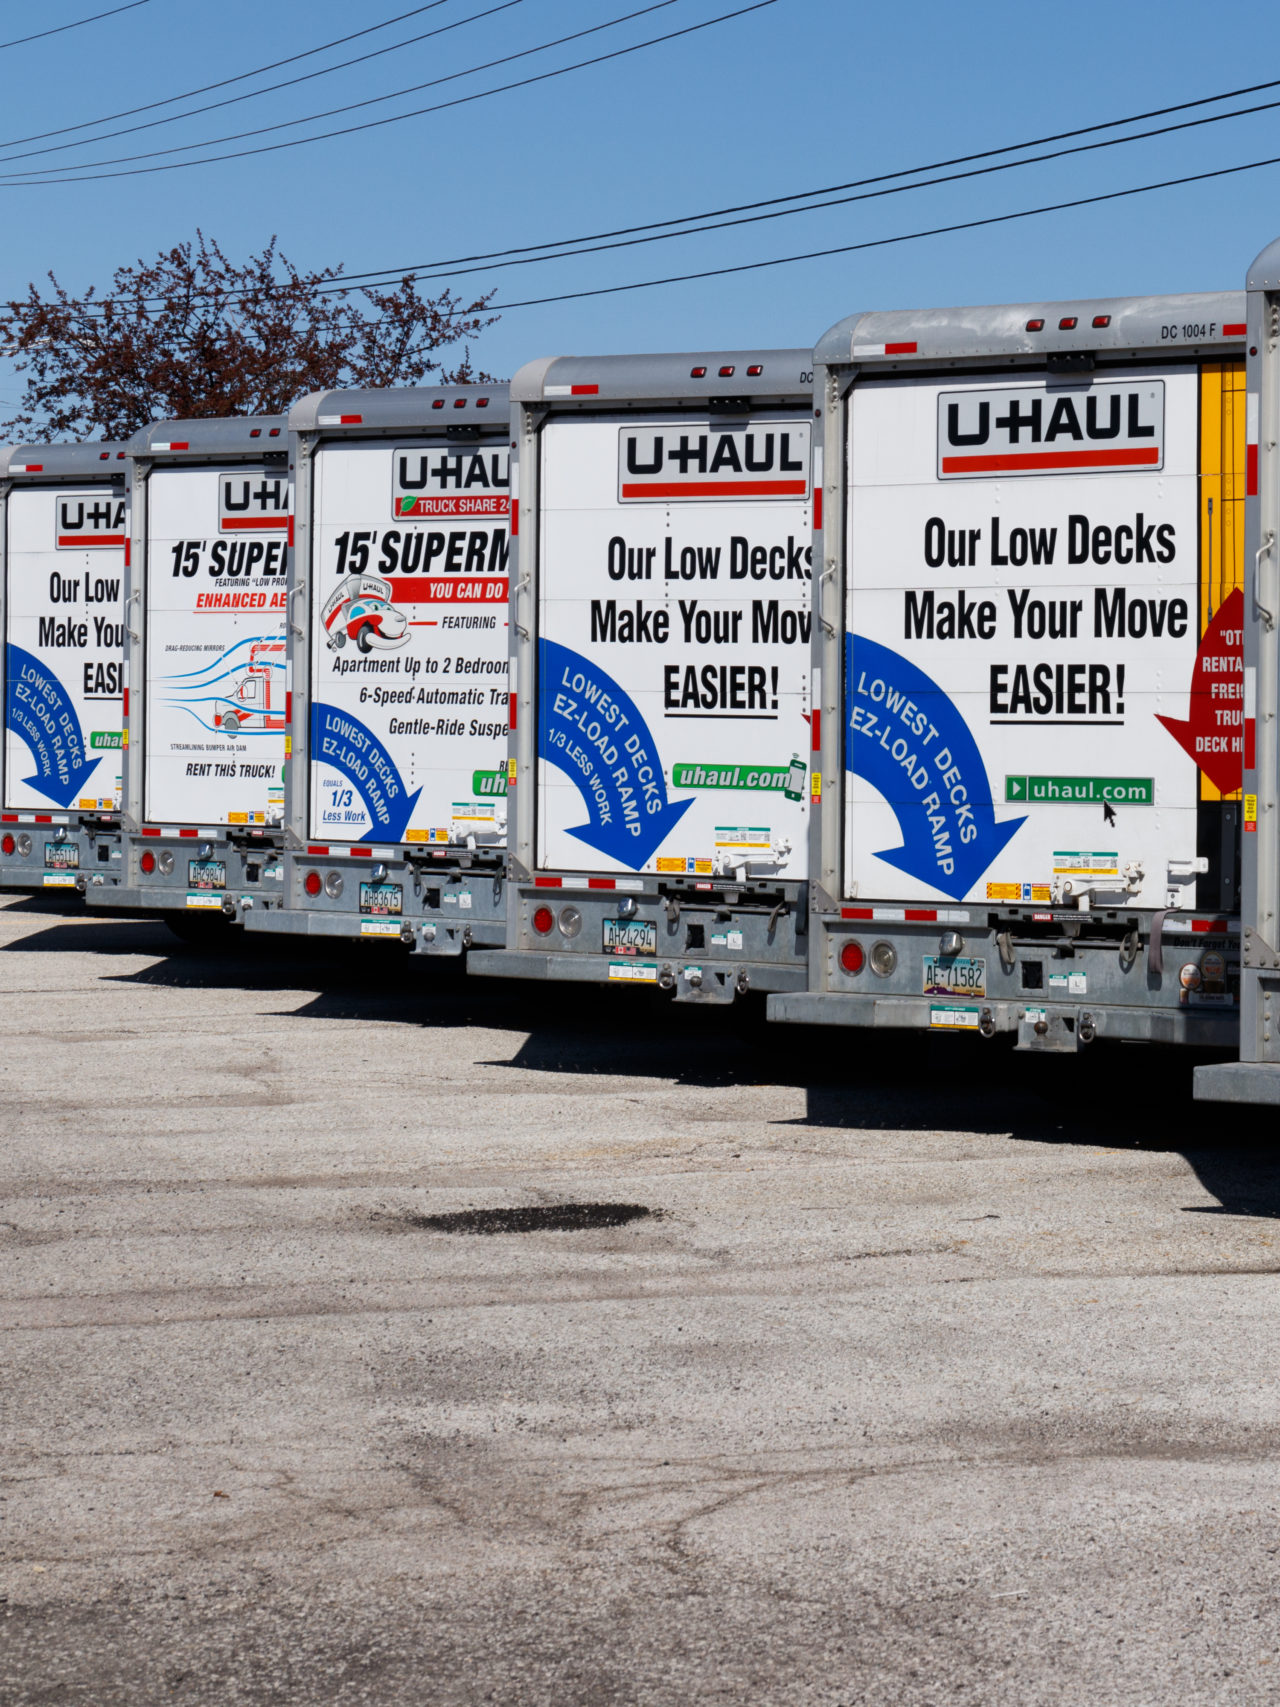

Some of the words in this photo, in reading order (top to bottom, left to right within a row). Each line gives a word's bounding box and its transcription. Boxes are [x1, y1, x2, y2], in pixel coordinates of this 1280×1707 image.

[1161, 325, 1178, 339] DC
[1182, 324, 1206, 338] 1004
[1209, 323, 1216, 336] F
[800, 372, 813, 384] DC
[947, 393, 1155, 446] U-HAUL
[627, 432, 803, 475] U-HAUL
[419, 499, 456, 513] TRUCK
[459, 498, 496, 512] SHARE
[924, 516, 981, 568] Our
[991, 516, 1057, 567] Low
[1068, 512, 1176, 565] Decks
[607, 536, 656, 581] Our
[664, 536, 721, 580] Low
[50, 571, 80, 603] Our
[85, 571, 120, 602] Low
[215, 577, 250, 587] FEATURING
[430, 582, 453, 598] YOU
[457, 582, 482, 598] CAN
[485, 582, 503, 598] DO
[196, 593, 266, 608] ENHANCED
[269, 592, 287, 607] AE
[442, 616, 496, 629] FEATURING
[590, 600, 670, 644] Make
[678, 600, 743, 644] Your
[752, 600, 812, 644] Mov
[904, 589, 997, 640] Make
[1007, 588, 1083, 639] Your
[1094, 587, 1188, 639] Move
[39, 616, 88, 648] Make
[165, 644, 201, 652] DRAG-REDUCING
[203, 644, 225, 652] MIRRORS
[332, 656, 400, 676] Apartment
[404, 656, 421, 676] Up
[425, 658, 439, 673] to
[442, 658, 451, 674] 2
[359, 686, 413, 707] 6-Speed
[417, 687, 485, 706] Automatic
[664, 664, 779, 710] EASIER!
[989, 662, 1125, 715] EASIER!
[21, 663, 62, 711] LOWEST
[59, 712, 82, 769] DECKS
[389, 718, 465, 736] Gentle-Ride
[15, 683, 56, 738] EZ-LOAD
[51, 737, 70, 785] RAMP
[561, 666, 629, 732] LOWEST
[624, 734, 662, 815] DECKS
[1196, 736, 1228, 753] DECK
[22, 717, 40, 745] LESS
[37, 742, 51, 777] WORK
[170, 743, 204, 751] STREAMLINING
[205, 743, 225, 752] BUMPER
[227, 744, 235, 752] AIR
[236, 744, 247, 752] DAM
[325, 714, 371, 753] LOWEST
[368, 748, 398, 799] DECKS
[857, 671, 939, 746] LOWEST
[934, 747, 977, 844] DECKS
[186, 763, 211, 777] RENT
[214, 763, 236, 777] THIS
[239, 764, 276, 778] TRUCK!
[553, 693, 618, 765] EZ-LOAD
[612, 767, 641, 837] RAMP
[323, 737, 369, 781] EZ-LOAD
[365, 777, 390, 825] RAMP
[323, 779, 343, 788] EQUALS
[480, 774, 508, 793] uh
[548, 728, 567, 748] 1/3
[565, 740, 594, 776] LESS
[588, 773, 613, 826] WORK
[680, 766, 791, 788] uhaul.com
[331, 790, 353, 808] 1/3
[849, 706, 929, 790] EZ-LOAD
[922, 792, 955, 875] RAMP
[1033, 781, 1146, 800] uhaul.com
[323, 810, 341, 822] Less
[344, 810, 366, 822] Work
[608, 927, 652, 947] AH24294
